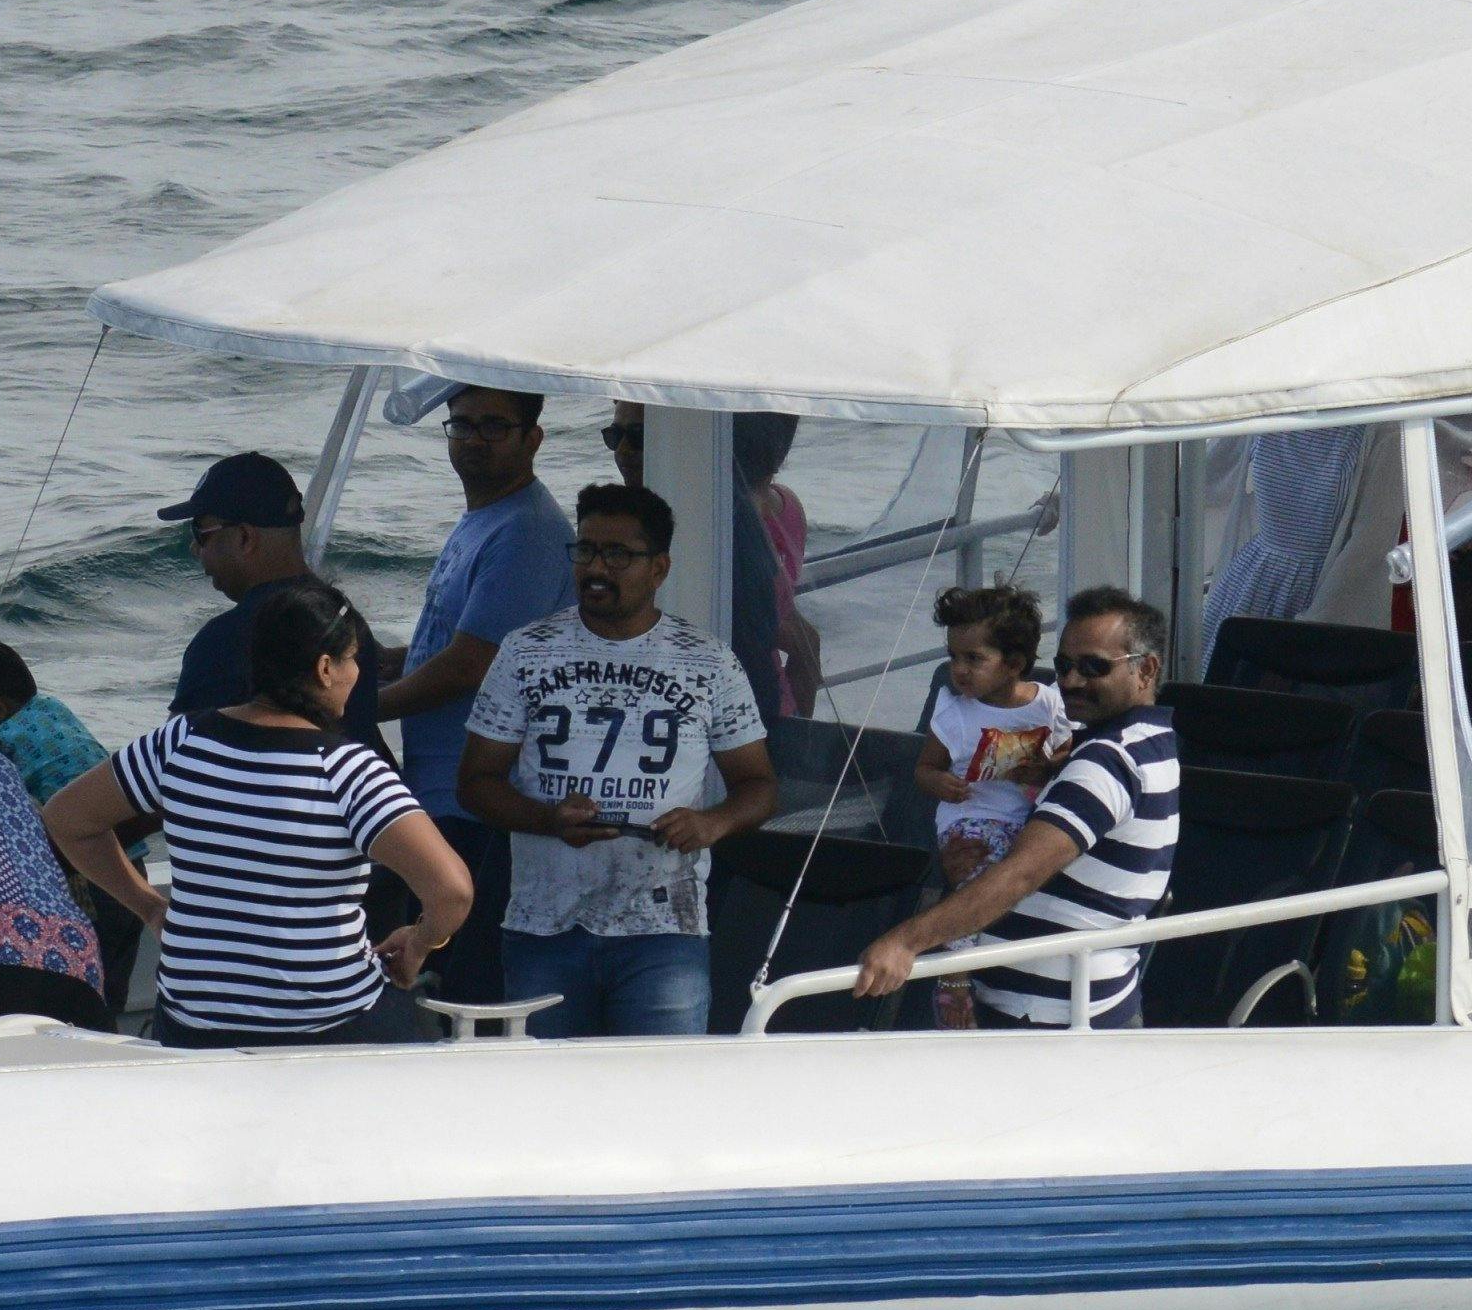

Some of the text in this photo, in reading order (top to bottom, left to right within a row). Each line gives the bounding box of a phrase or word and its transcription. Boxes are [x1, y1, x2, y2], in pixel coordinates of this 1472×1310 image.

[527, 660, 696, 715] SAN FRANCISCO
[536, 704, 679, 774] 279
[538, 772, 670, 800] RETRO GLORY
[625, 800, 655, 810] GOODS
